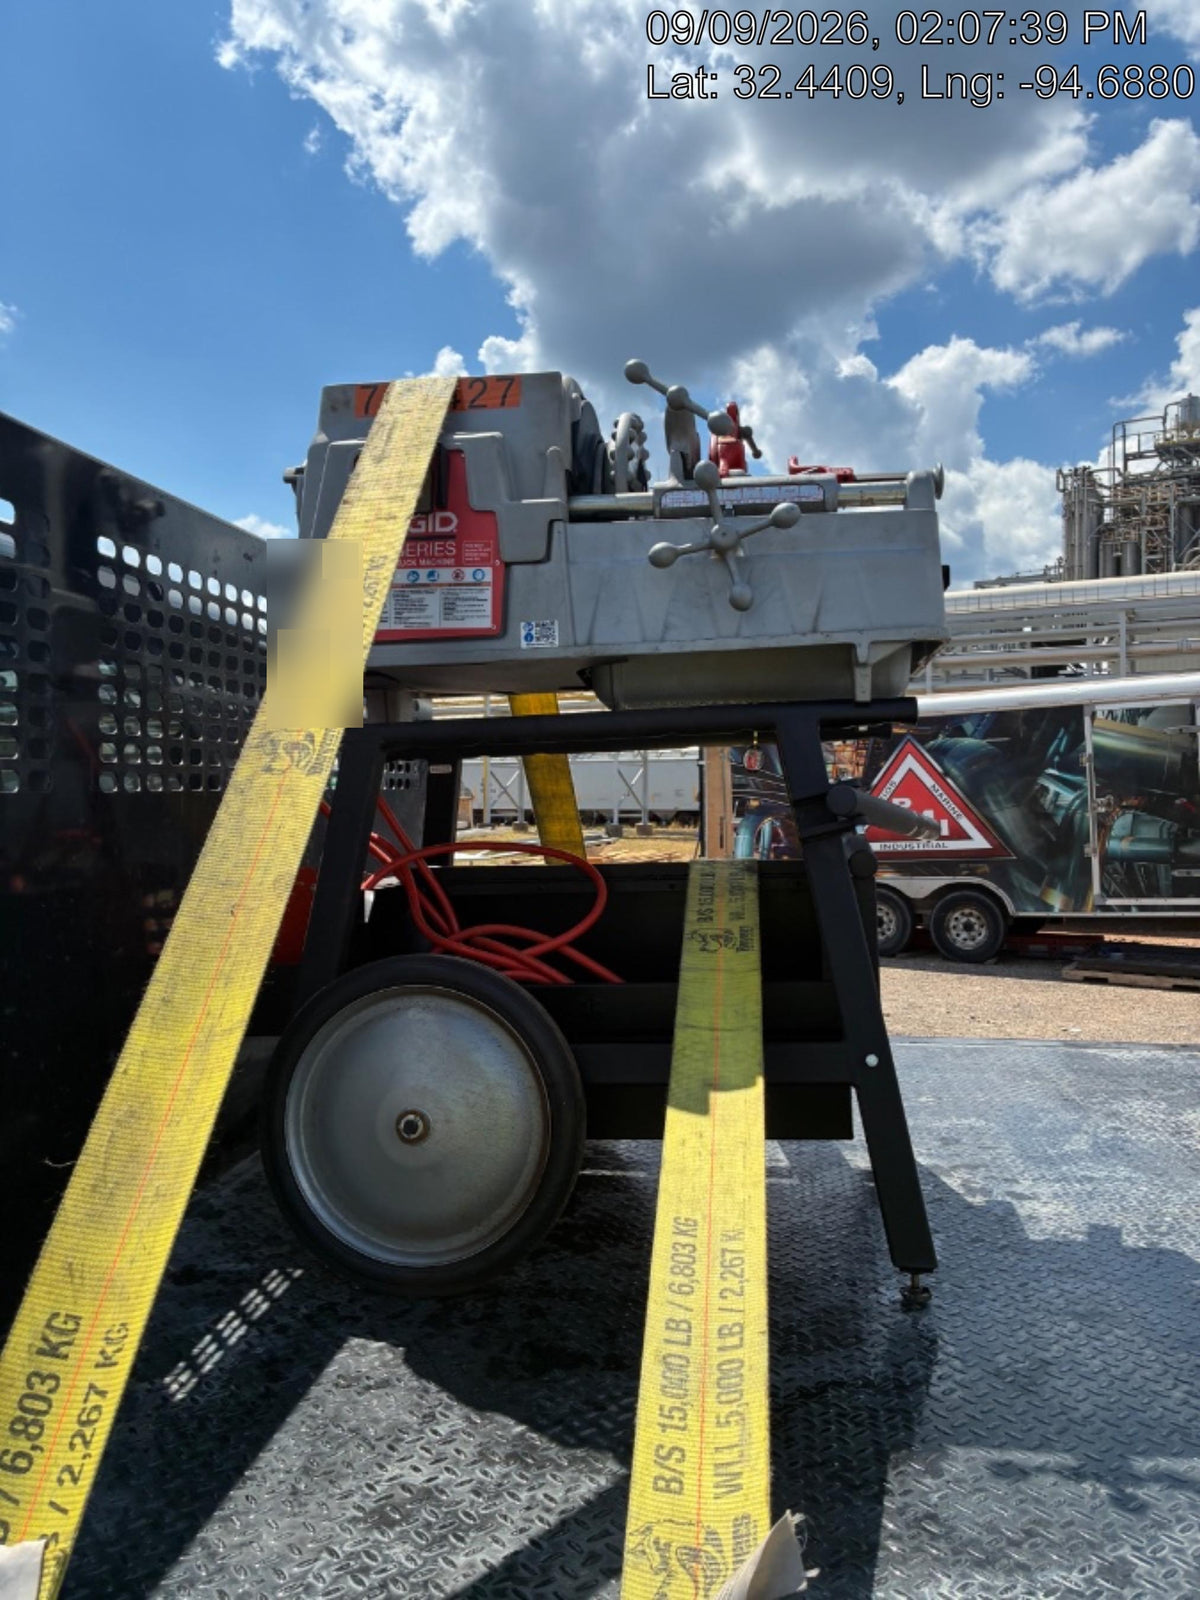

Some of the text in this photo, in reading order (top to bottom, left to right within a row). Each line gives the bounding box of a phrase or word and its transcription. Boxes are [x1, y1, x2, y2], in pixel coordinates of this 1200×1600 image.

[880, 841, 948, 851] INDUSTRIAL
[672, 1216, 698, 1239] KG
[668, 1241, 699, 1296] 6,803
[719, 1247, 746, 1301] 2,267
[663, 1318, 692, 1347] LB
[717, 1321, 744, 1352] LB
[0, 1369, 61, 1475] 6,803
[35, 1311, 83, 1360] KG
[56, 1382, 109, 1488] 2,267
[94, 1322, 129, 1369] KG
[659, 1352, 694, 1434] 15,000
[715, 1357, 747, 1429] 5,000
[652, 1442, 686, 1496] B/S
